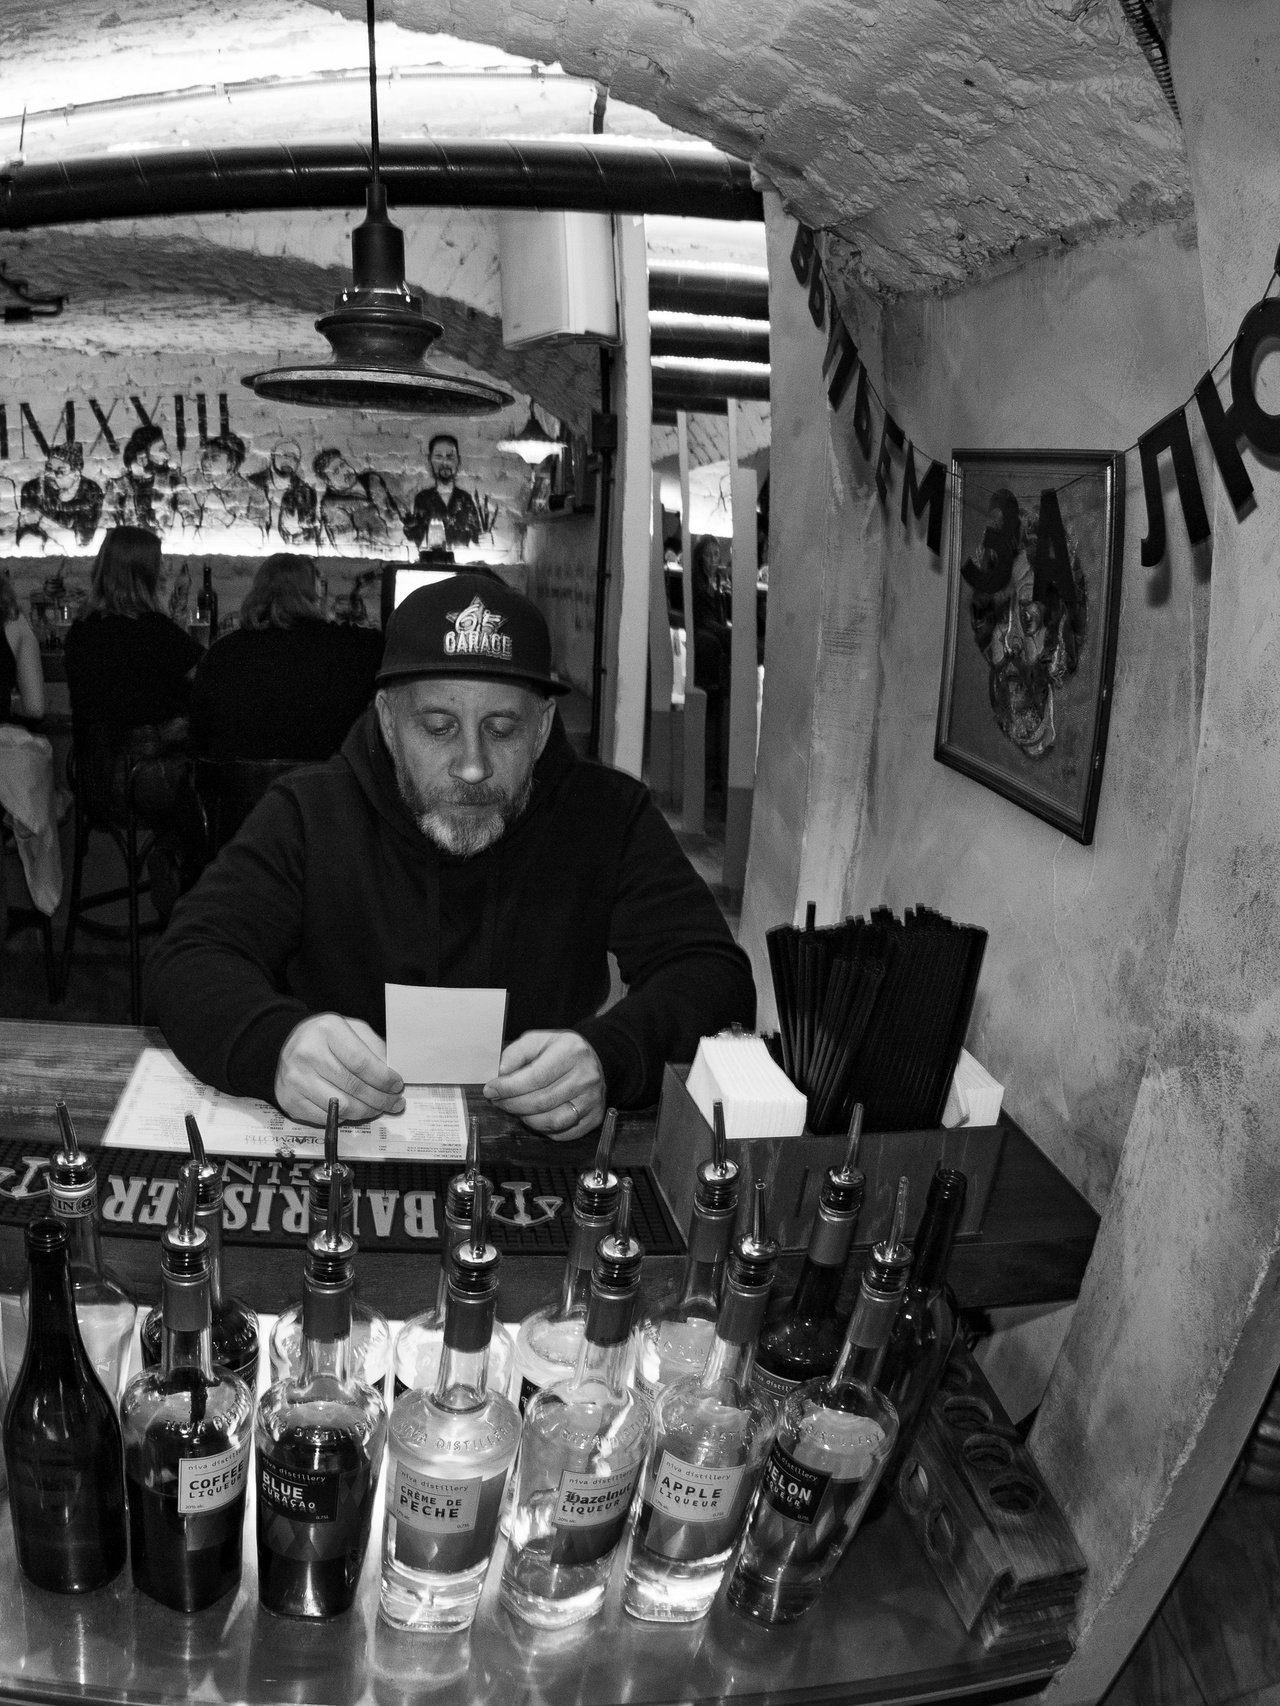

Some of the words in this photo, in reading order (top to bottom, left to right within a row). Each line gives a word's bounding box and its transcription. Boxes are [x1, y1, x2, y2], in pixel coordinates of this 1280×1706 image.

[961, 488, 1077, 602] ЗА
[1138, 243, 1280, 567] ЛЮ
[444, 631, 513, 660] GARAGE
[102, 1174, 440, 1239] BARISER
[188, 1462, 208, 1471] niva
[189, 1460, 245, 1491] COFFEE
[279, 1466, 326, 1483] distillery
[666, 1461, 682, 1473] niva
[685, 1470, 731, 1480] distillery
[189, 1473, 242, 1499] LIQUEUR
[262, 1470, 304, 1500] BLUE
[401, 1471, 417, 1483] niva
[421, 1481, 469, 1492] distillery
[661, 1476, 723, 1498] APPLE
[764, 1469, 801, 1507] IQUEUR
[766, 1456, 812, 1501] MELON
[262, 1485, 316, 1509] CURAÇAO
[401, 1485, 437, 1505] CRÈME
[446, 1499, 462, 1507] DE
[564, 1482, 631, 1505] Hazelnut
[659, 1487, 718, 1507] LIQUEUR
[562, 1500, 620, 1514] LIQUEUR
